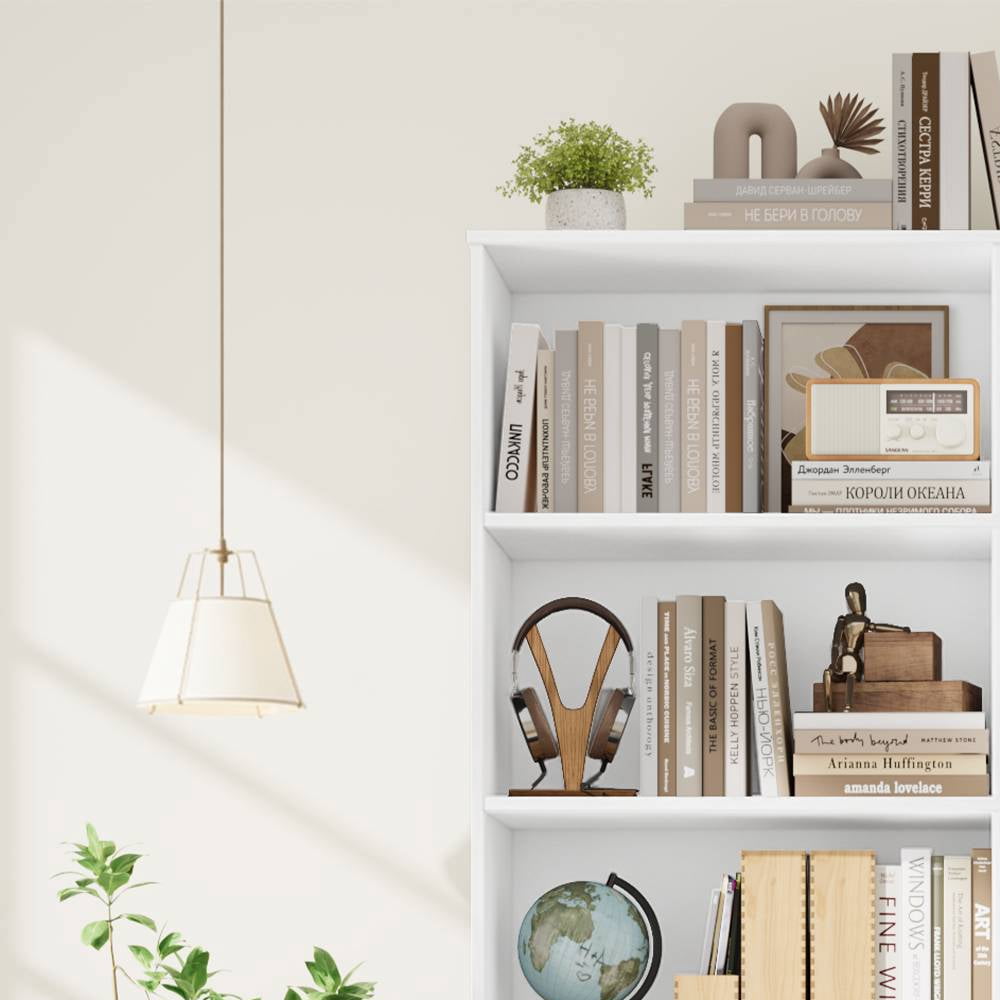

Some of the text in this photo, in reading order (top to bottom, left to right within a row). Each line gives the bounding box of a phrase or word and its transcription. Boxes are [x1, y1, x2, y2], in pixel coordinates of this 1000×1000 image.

[898, 120, 907, 203] СТИХОТВОРЕНИЯ
[919, 117, 932, 208] СЕСТРА КЕРРИ
[736, 185, 767, 197] ДАВИД
[745, 207, 863, 222] НЕ БЕРИ В ГОЛОВУ
[798, 466, 891, 476] Джордан Элленберг
[846, 486, 966, 500] КОРОЛИ ОКЕАНА
[645, 652, 655, 692] design
[683, 627, 697, 688] Álvaro Siza
[708, 638, 718, 752] THE BASIC OF FORMAT
[730, 646, 740, 764] KELLY HOPPEN STYLE
[756, 687, 774, 777] НЬЮ-ЙОРК
[828, 758, 953, 772] Arianna Huffington
[844, 781, 943, 794] amanda lovelace
[879, 896, 896, 954] FINE
[908, 856, 924, 950] WINDOWS
[975, 903, 992, 940] ART
